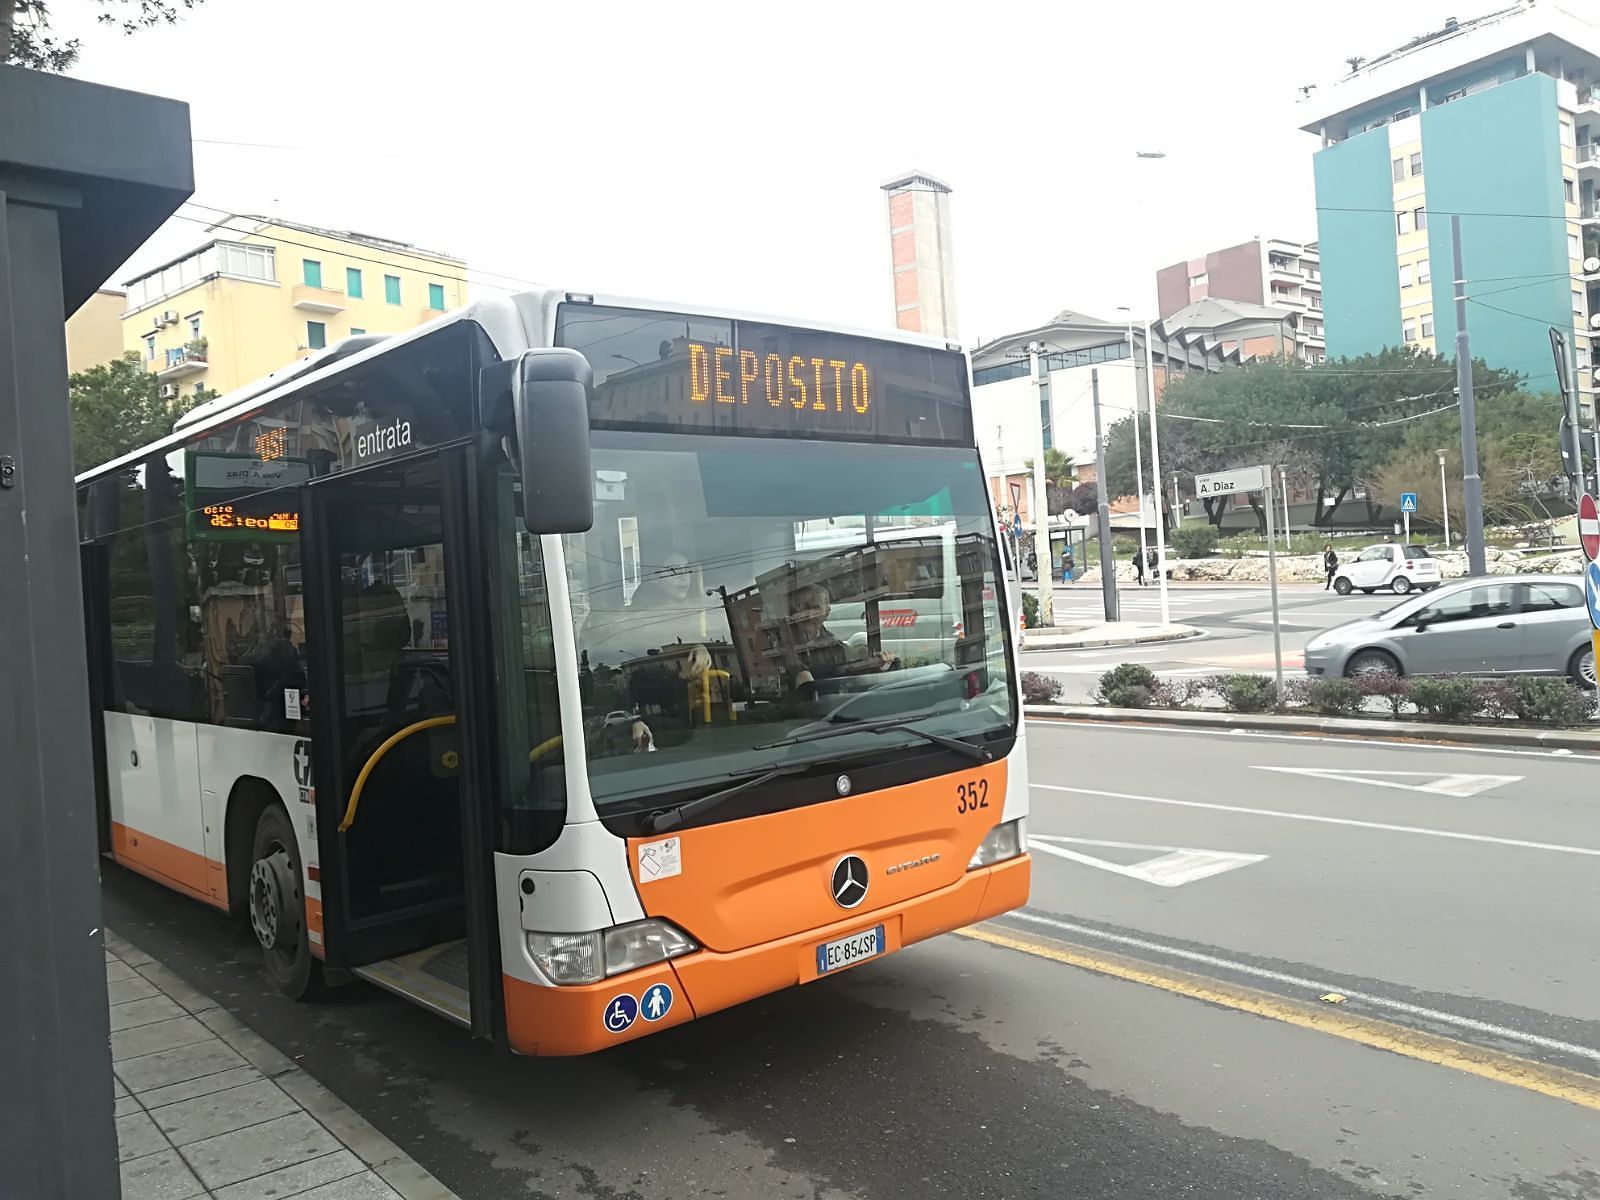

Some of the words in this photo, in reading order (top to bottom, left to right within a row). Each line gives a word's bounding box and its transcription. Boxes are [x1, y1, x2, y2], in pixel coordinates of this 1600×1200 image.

[688, 343, 869, 414] DEPOSITO
[358, 417, 411, 458] entrata
[1200, 484, 1211, 494] A.
[1213, 481, 1235, 492] Diaz
[957, 778, 989, 814] 352
